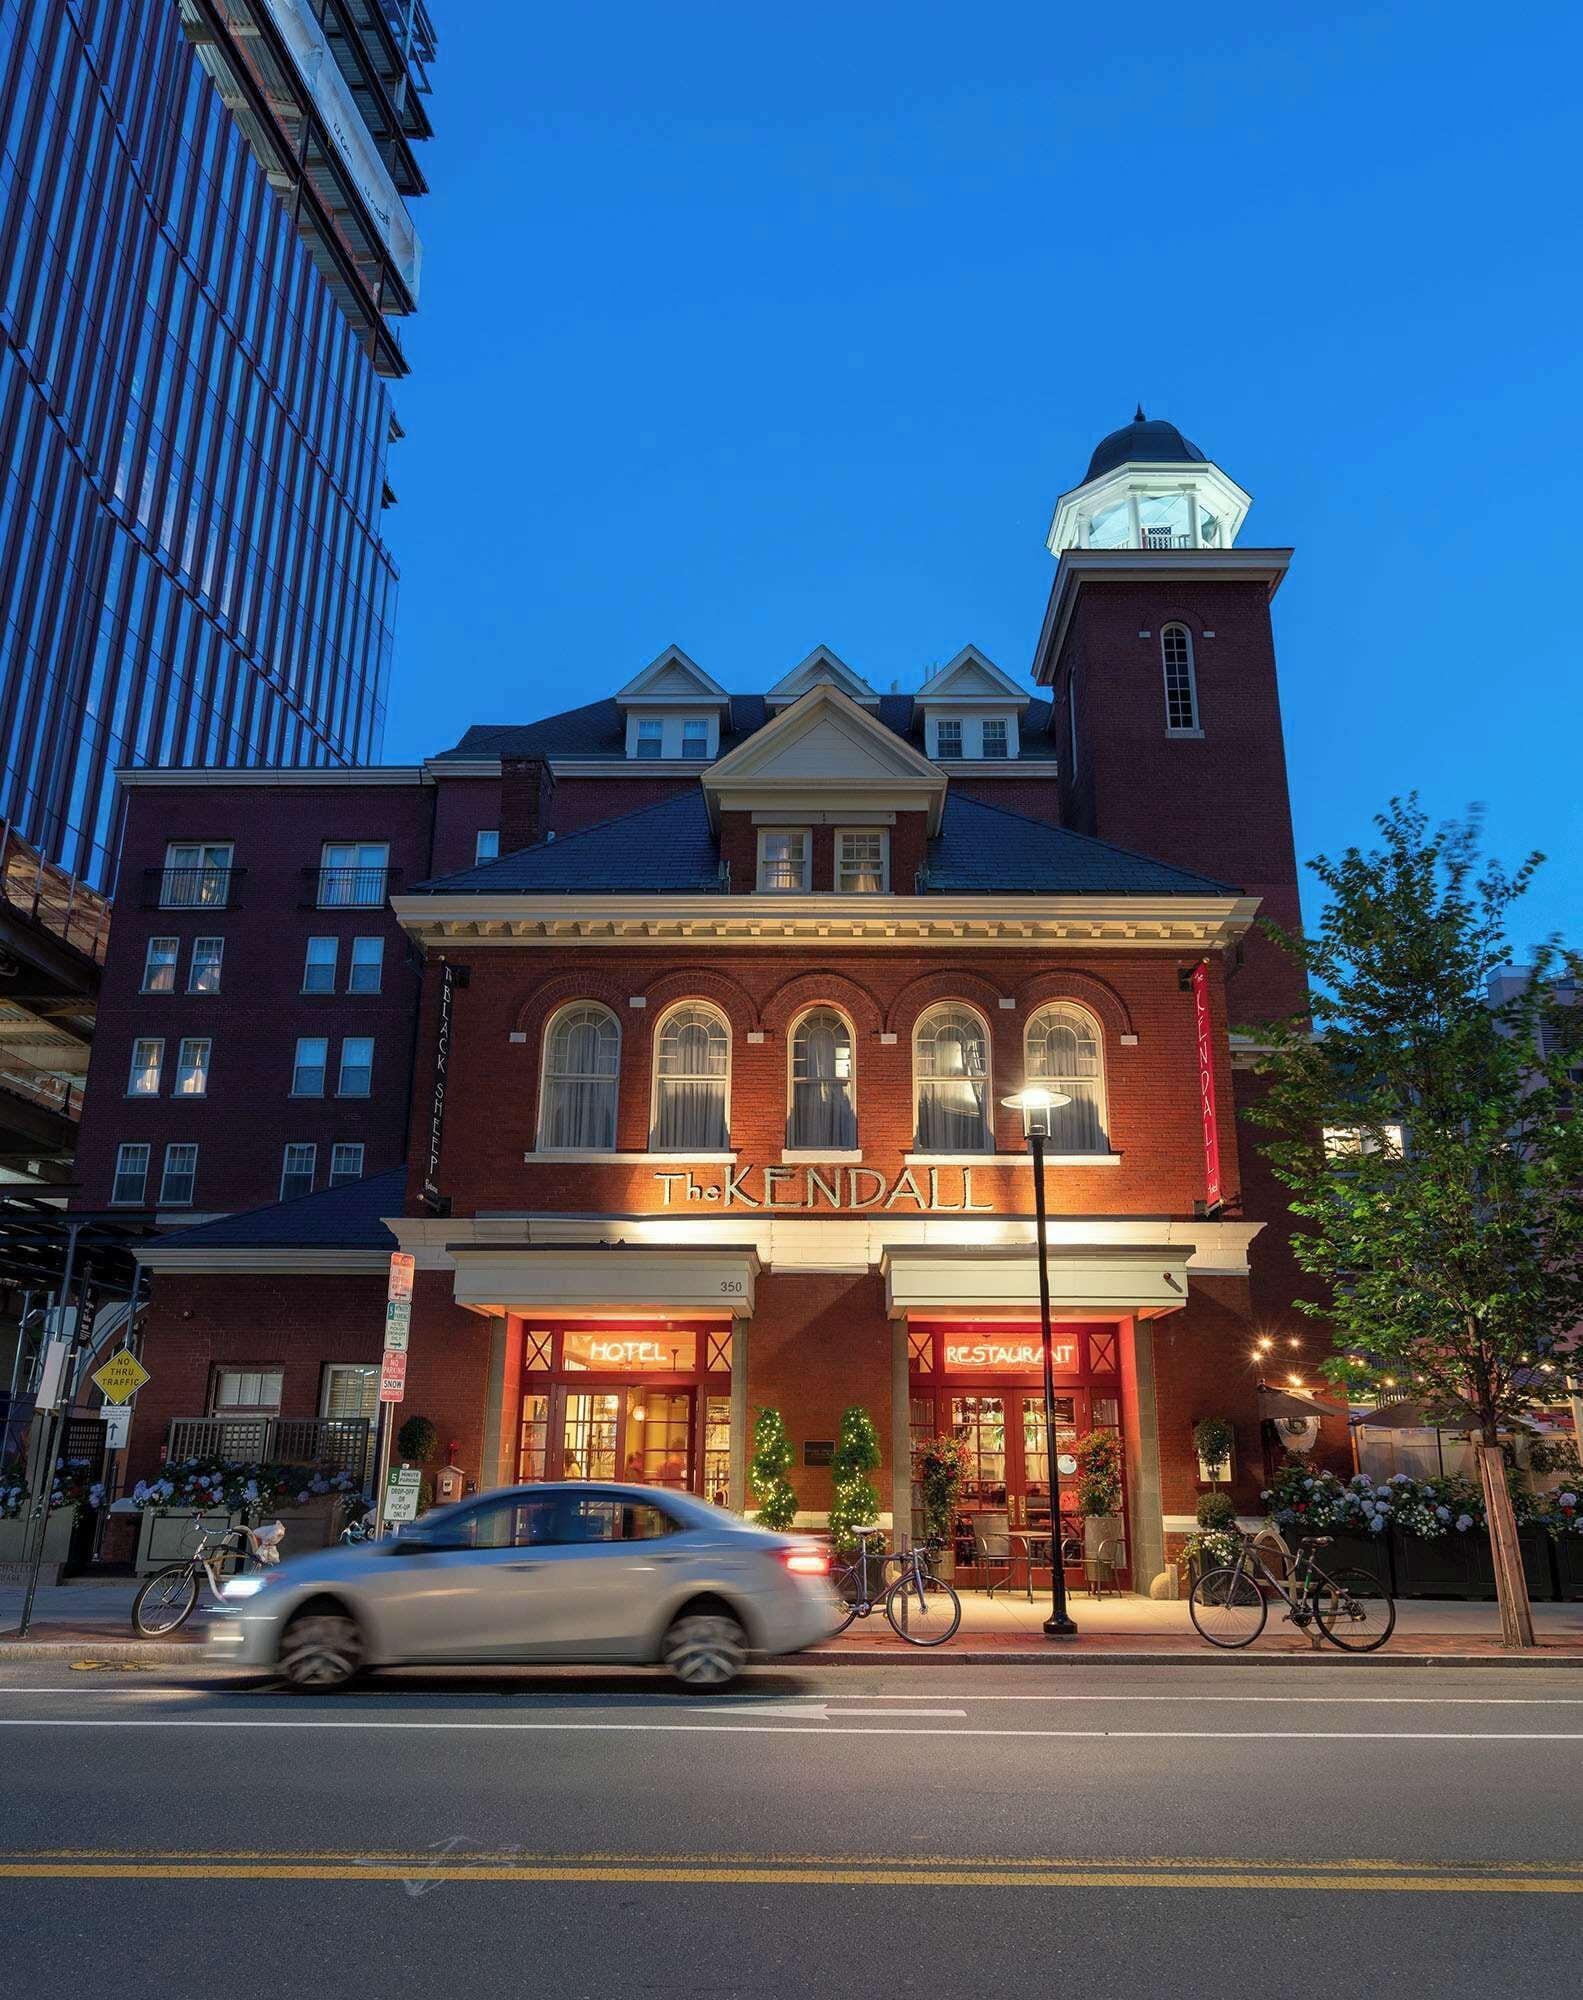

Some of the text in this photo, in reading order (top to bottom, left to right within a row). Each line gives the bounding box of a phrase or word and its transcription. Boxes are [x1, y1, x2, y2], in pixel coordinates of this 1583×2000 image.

[437, 984, 452, 1073] BLACK
[430, 1083, 444, 1174] SHEEP
[654, 1163, 993, 1211] The KENDALL
[720, 1281, 742, 1292] 350
[590, 1341, 667, 1362] HOTEL
[945, 1345, 1074, 1364] RESTAURANT
[117, 1358, 130, 1366] NO
[110, 1368, 134, 1376] THRU
[383, 1366, 405, 1374] PARKING
[102, 1378, 140, 1386] TRAFFIC
[384, 1380, 402, 1388] SNOW
[391, 1473, 397, 1483] 5
